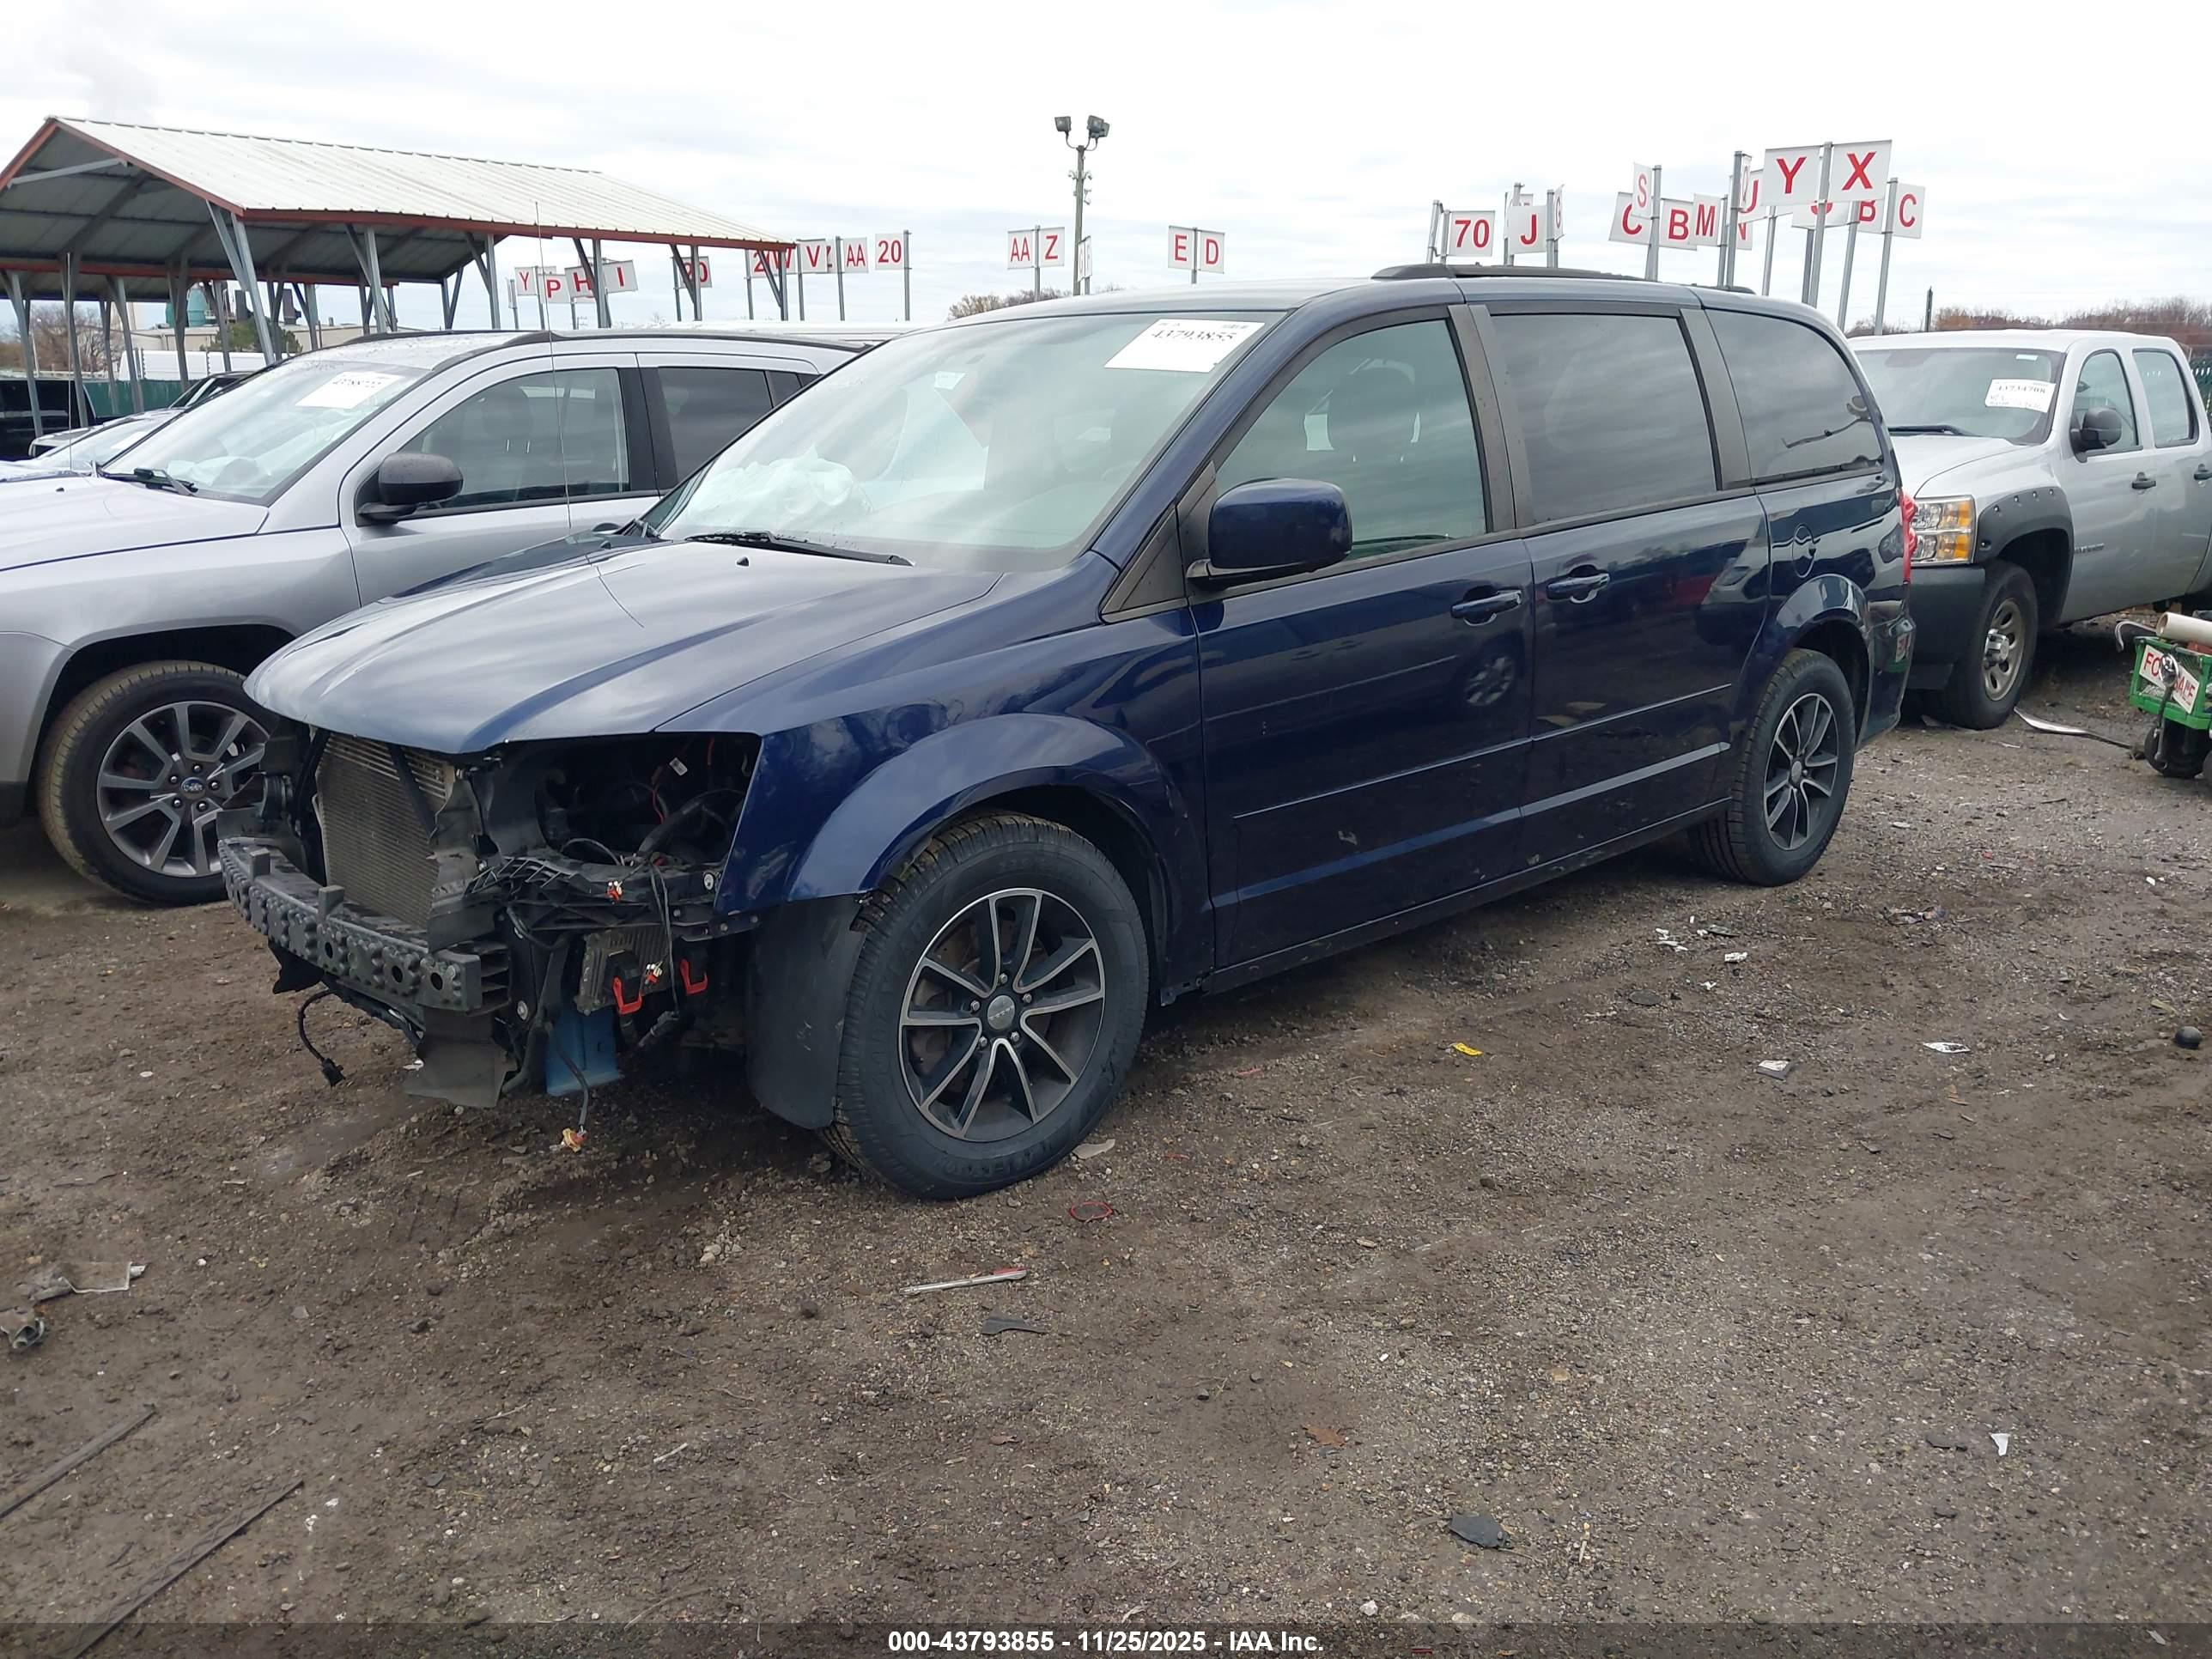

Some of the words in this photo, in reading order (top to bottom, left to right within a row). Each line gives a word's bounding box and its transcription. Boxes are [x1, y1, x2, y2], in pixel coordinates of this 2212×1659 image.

[1776, 157, 1807, 194] Y
[1842, 151, 1877, 191] X
[1637, 173, 1647, 208] S
[1621, 204, 1643, 235] C
[1668, 209, 1689, 240] B
[1695, 204, 1716, 237] M
[1899, 194, 1917, 228] C
[1455, 219, 1490, 248] 70
[1520, 214, 1537, 245] J
[806, 245, 821, 268] V
[846, 244, 866, 267] AA
[878, 240, 902, 264] 20
[1010, 237, 1030, 262] AA
[1044, 234, 1058, 260] Z
[1174, 234, 1188, 262] E
[1206, 239, 1219, 264] D
[519, 271, 530, 290] Y
[546, 279, 561, 298] P
[573, 271, 592, 292] H
[617, 267, 624, 287] I
